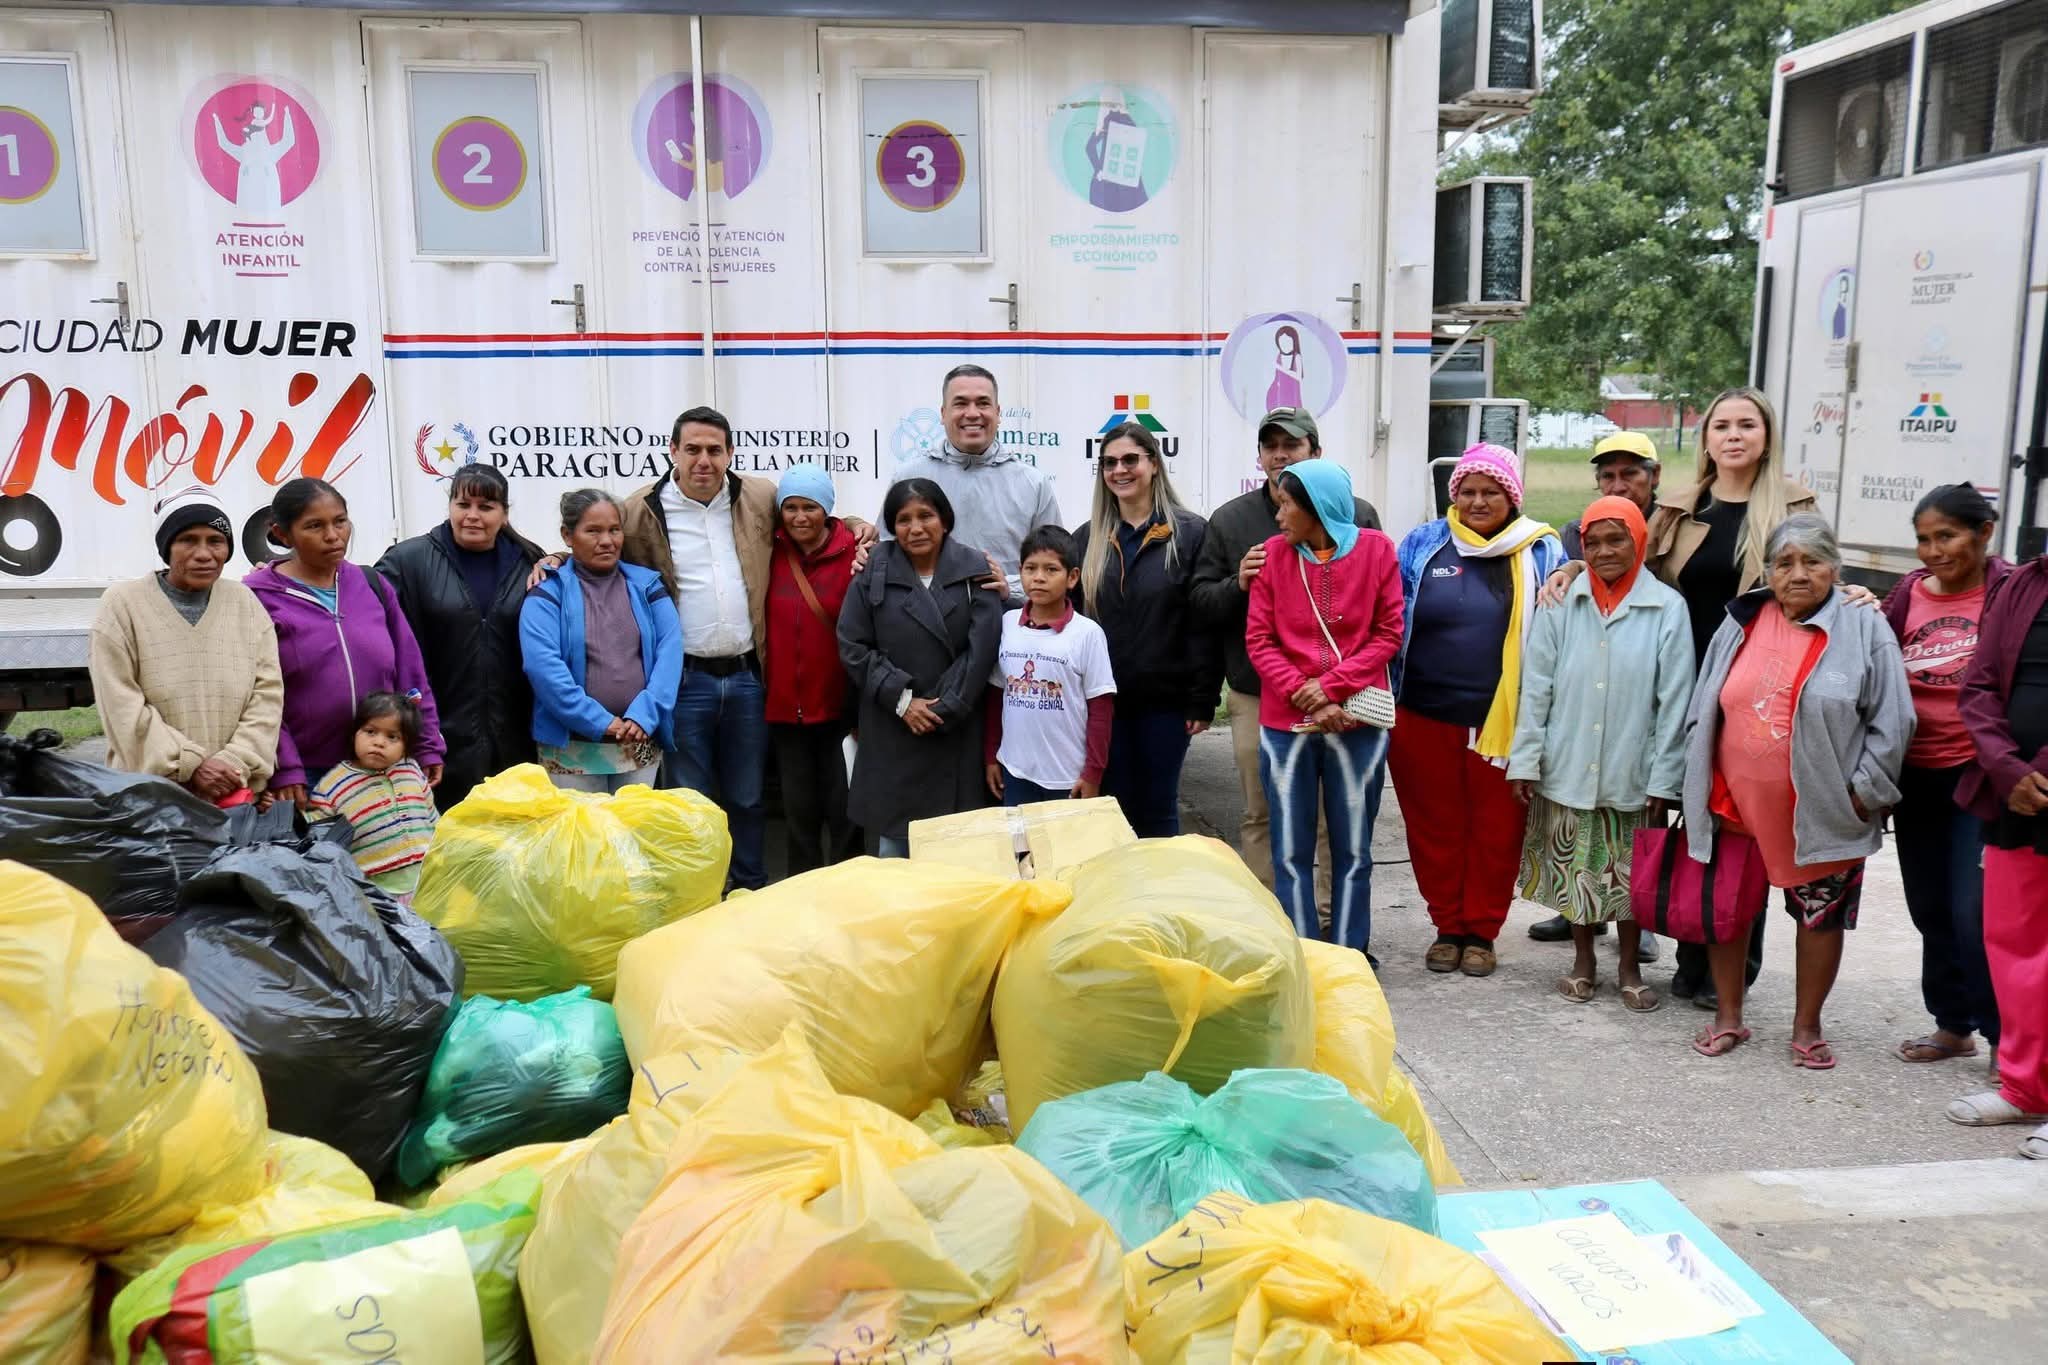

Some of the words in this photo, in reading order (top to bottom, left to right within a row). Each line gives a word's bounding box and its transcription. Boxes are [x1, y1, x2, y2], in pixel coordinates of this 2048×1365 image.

[0, 134, 20, 176] 1
[463, 143, 493, 184] 2
[906, 145, 936, 188] 3
[216, 232, 305, 248] ATENCIÓN
[632, 231, 700, 242] PREVENCIÓ
[713, 232, 722, 241] Y
[724, 231, 785, 243] ATENCIÓN
[222, 253, 301, 268] INFANTIL
[657, 247, 673, 257] DE
[677, 247, 692, 257] LA
[696, 247, 761, 258] OLENCIA
[644, 263, 693, 273] CONTRA
[723, 263, 776, 273] MUJERES
[0, 319, 164, 354] CIUDAD
[181, 319, 357, 357] MUJER
[1900, 419, 1957, 433] ITAIPU
[0, 372, 376, 505] Móvil
[489, 425, 643, 447] GOBIERNO
[730, 430, 850, 449] INISTERIO
[752, 454, 779, 471] LA
[1432, 567, 1450, 575] NDL
[1904, 633, 1978, 660] Detroit
[1038, 700, 1065, 711] GENIAL
